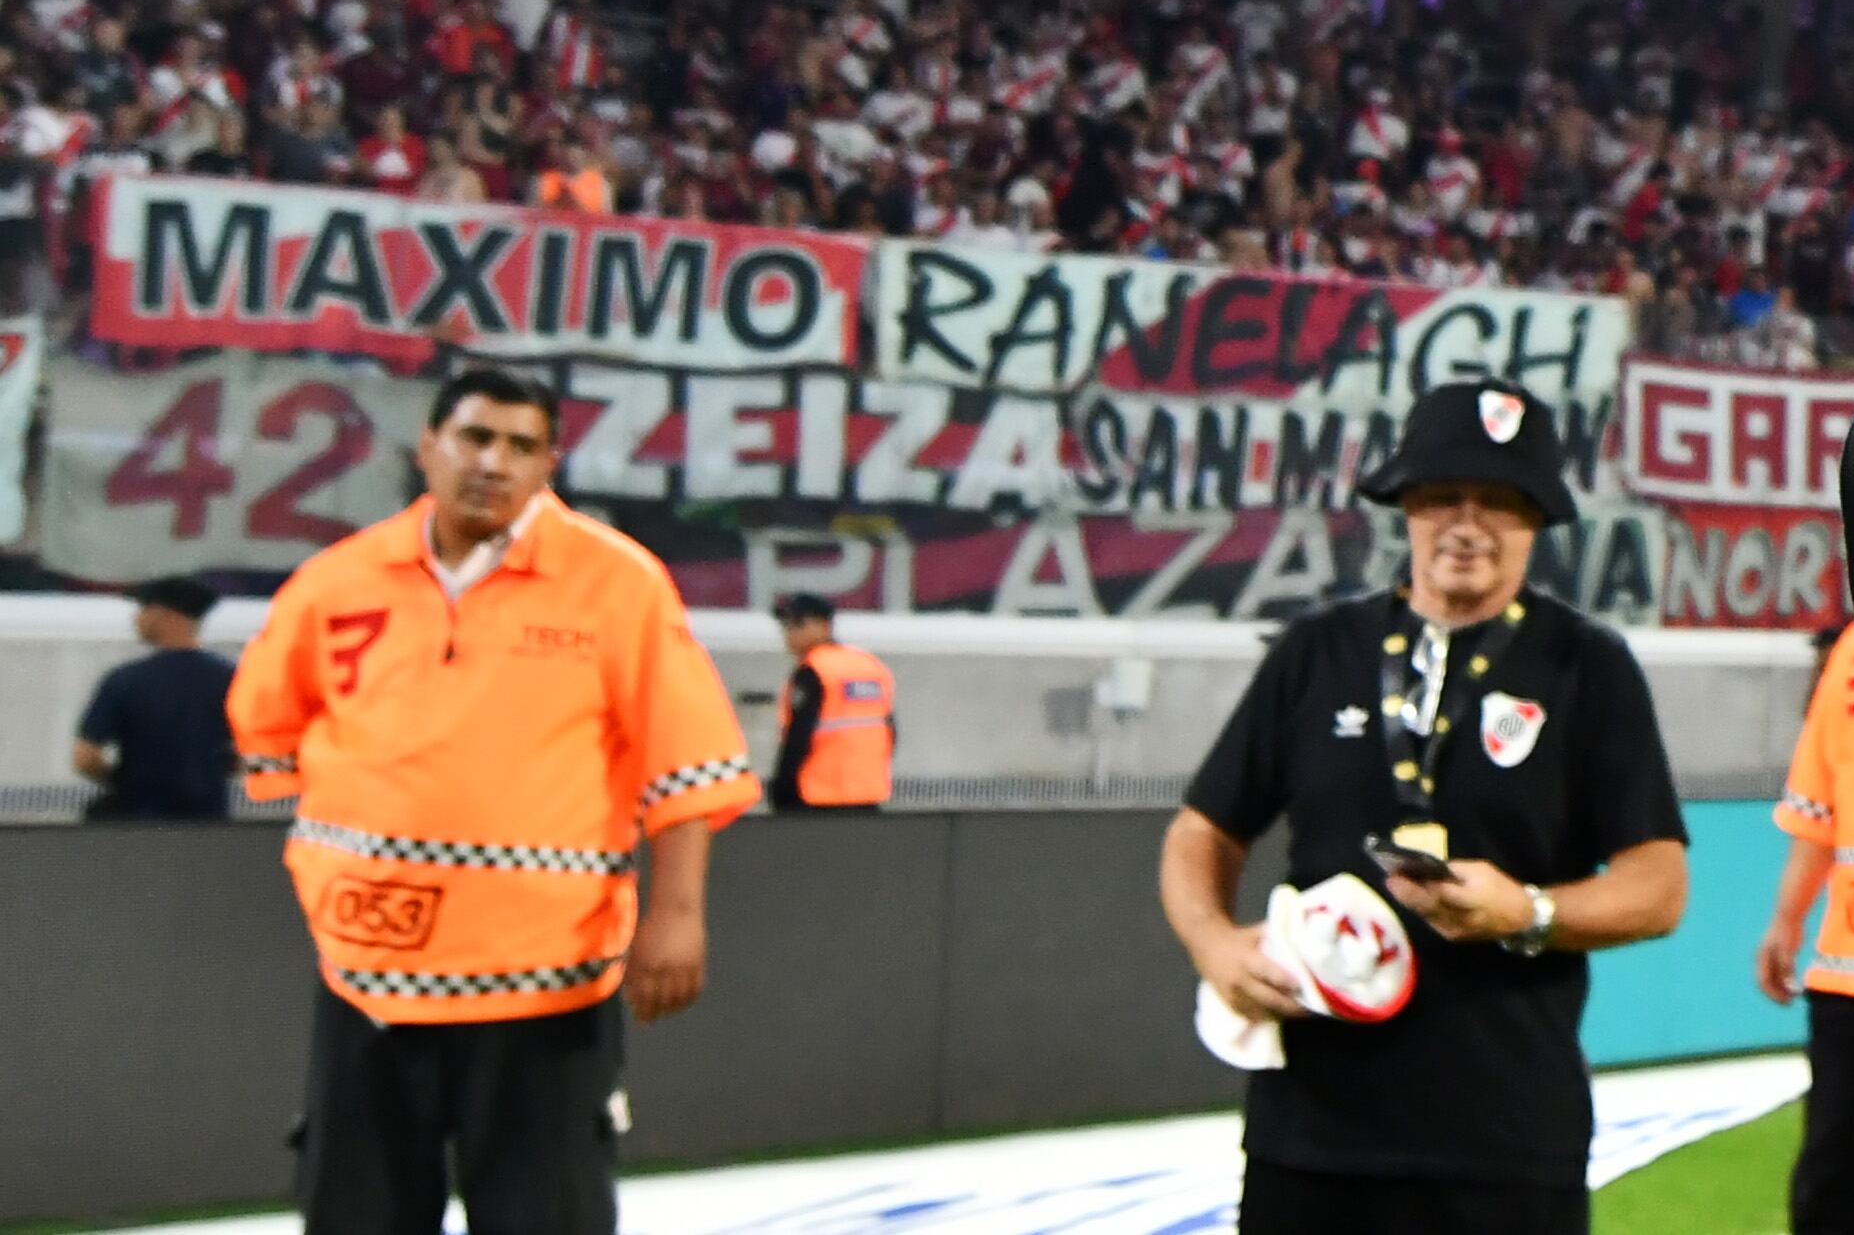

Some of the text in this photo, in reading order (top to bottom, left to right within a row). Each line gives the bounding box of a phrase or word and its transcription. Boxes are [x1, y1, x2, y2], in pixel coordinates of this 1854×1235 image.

[136, 198, 827, 351] MAXIMO
[899, 249, 1594, 398] RANELAGH
[104, 378, 376, 544] 42
[556, 364, 1090, 516] ZEIZA
[1665, 519, 1853, 620] NOR
[335, 890, 424, 933] 053
